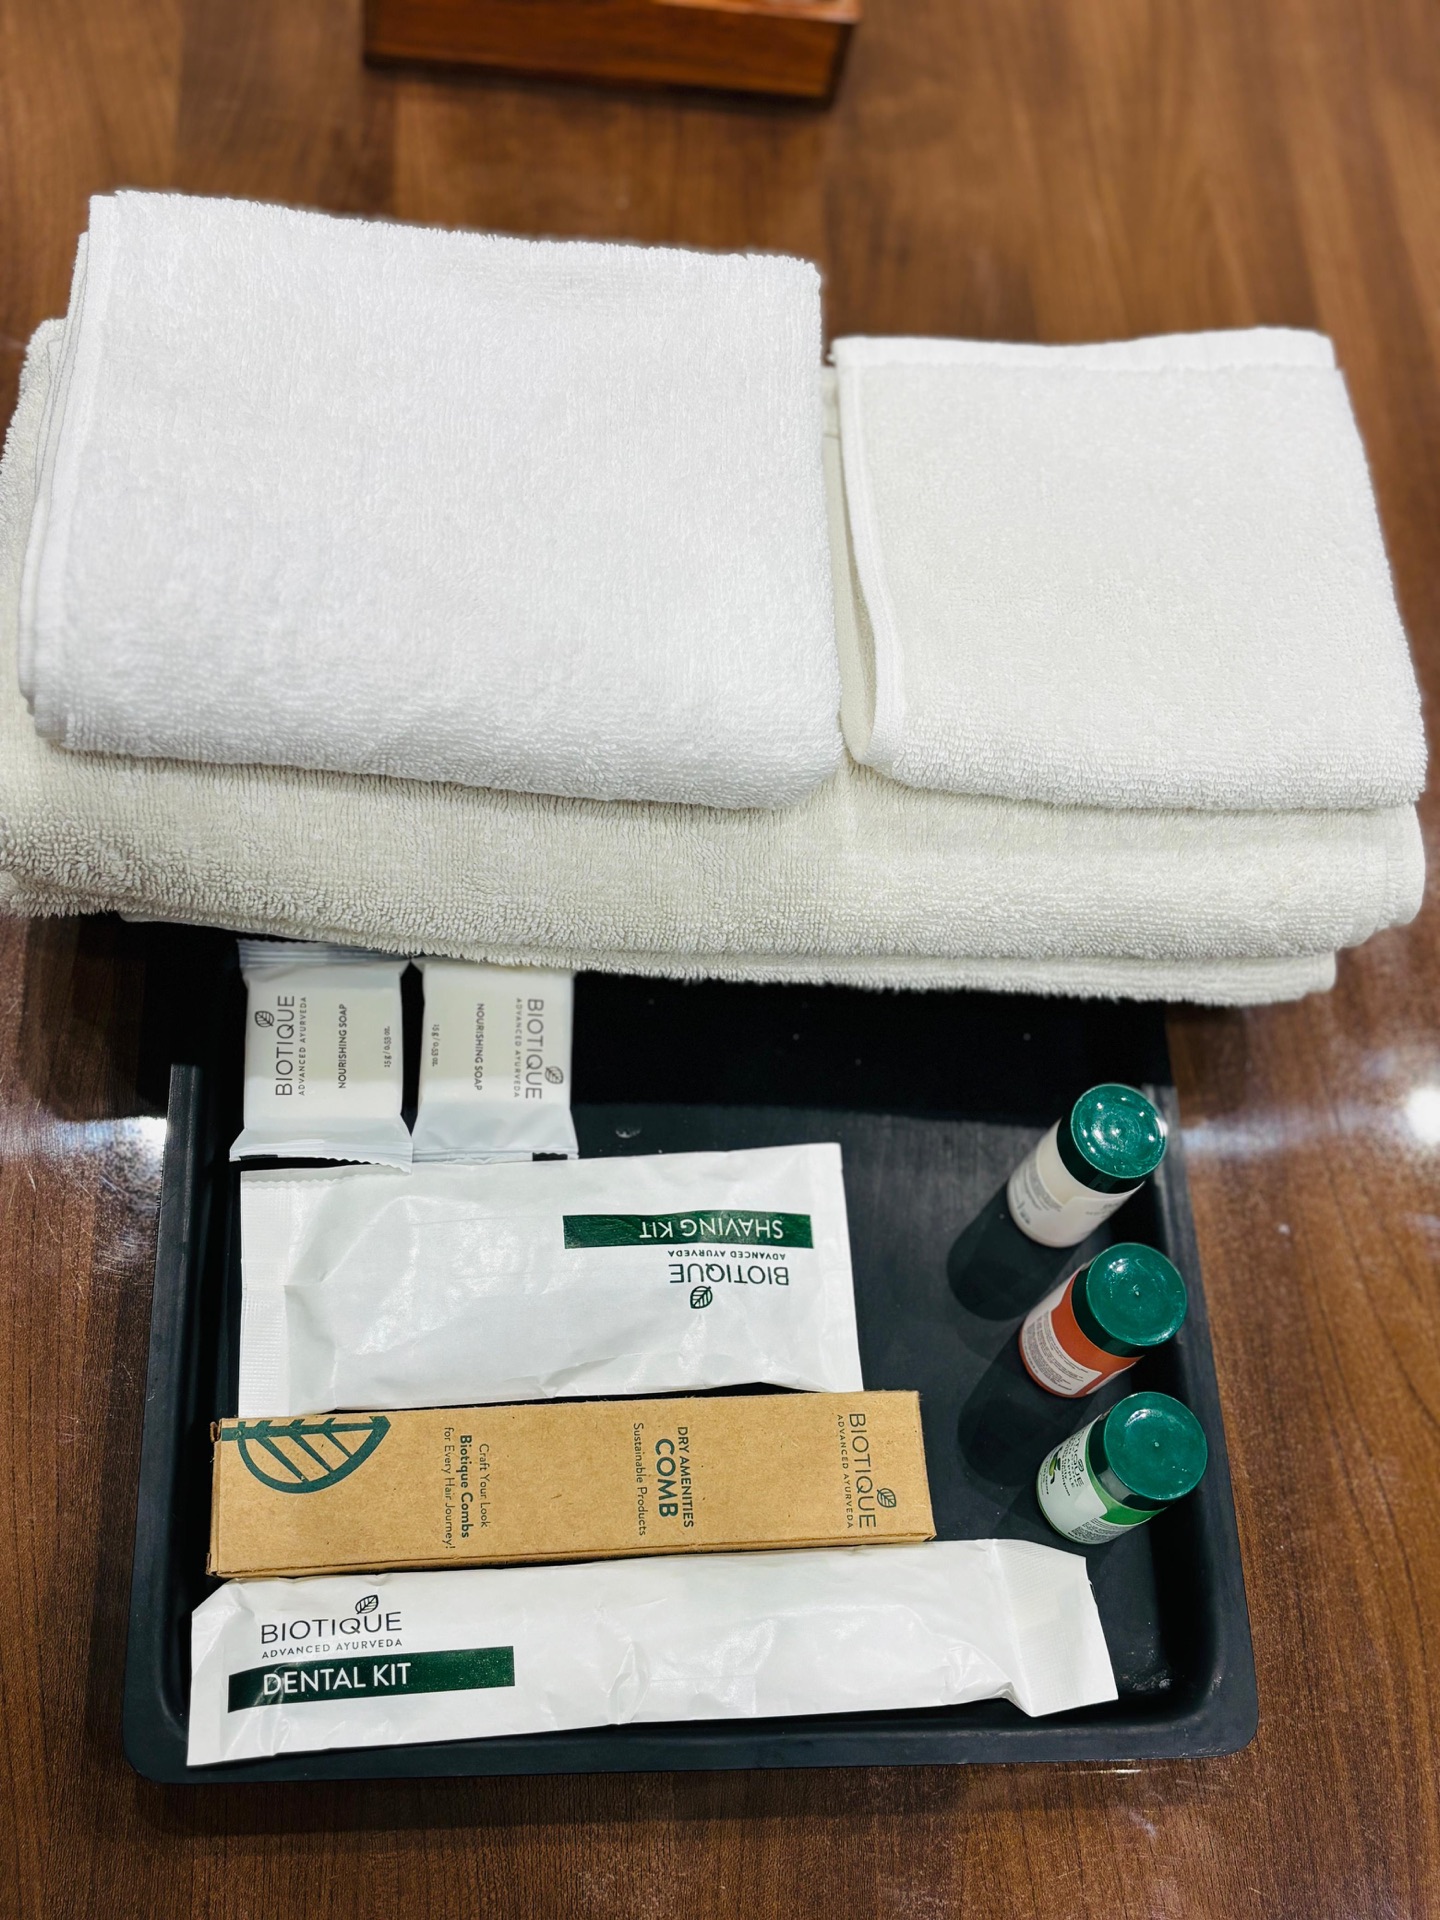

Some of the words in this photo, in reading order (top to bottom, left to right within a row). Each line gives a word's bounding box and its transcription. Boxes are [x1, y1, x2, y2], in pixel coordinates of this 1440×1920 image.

[299, 996, 307, 1043] AYURVEDA
[338, 1003, 348, 1028] SOAP
[474, 1003, 485, 1064] NOURISHING
[514, 998, 523, 1047] ADVANCED
[275, 995, 295, 1096] BIOTIQUE
[338, 1029, 347, 1089] NOURISHING
[525, 998, 544, 1099] BIOTIQUE
[298, 1046, 307, 1096] ADVANCED
[473, 1065, 484, 1091] SOAP
[513, 1050, 522, 1098] AYURVEDA
[639, 1221, 674, 1239] KIT
[680, 1217, 784, 1239] SHAVING
[668, 1249, 726, 1258] AYURVEDA
[730, 1251, 786, 1261] ADVANCED
[668, 1263, 790, 1286] BIOTIQUE
[444, 1427, 455, 1442] for
[633, 1422, 644, 1484] Sustainable
[677, 1426, 690, 1454] DRY
[441, 1445, 455, 1475] Every
[456, 1434, 473, 1489] Biotique
[479, 1443, 490, 1471] Craft
[837, 1414, 849, 1470] ADVANCED
[843, 1473, 854, 1529] AYURVEDA
[849, 1412, 877, 1529] BIOTIQUE
[445, 1477, 456, 1500] Hair
[480, 1473, 491, 1499] Your
[655, 1438, 679, 1518] COMB
[679, 1455, 694, 1529] AMENITIES
[442, 1502, 456, 1549] Journey!
[461, 1492, 474, 1539] Combs
[480, 1502, 491, 1528] Look
[636, 1486, 648, 1537] Products
[261, 1611, 403, 1645] BIOTIQUE
[261, 1643, 331, 1659] ADVANCED
[336, 1638, 403, 1651] AYURVEDA
[263, 1667, 366, 1696] DENTAL
[373, 1662, 411, 1687] KIT
